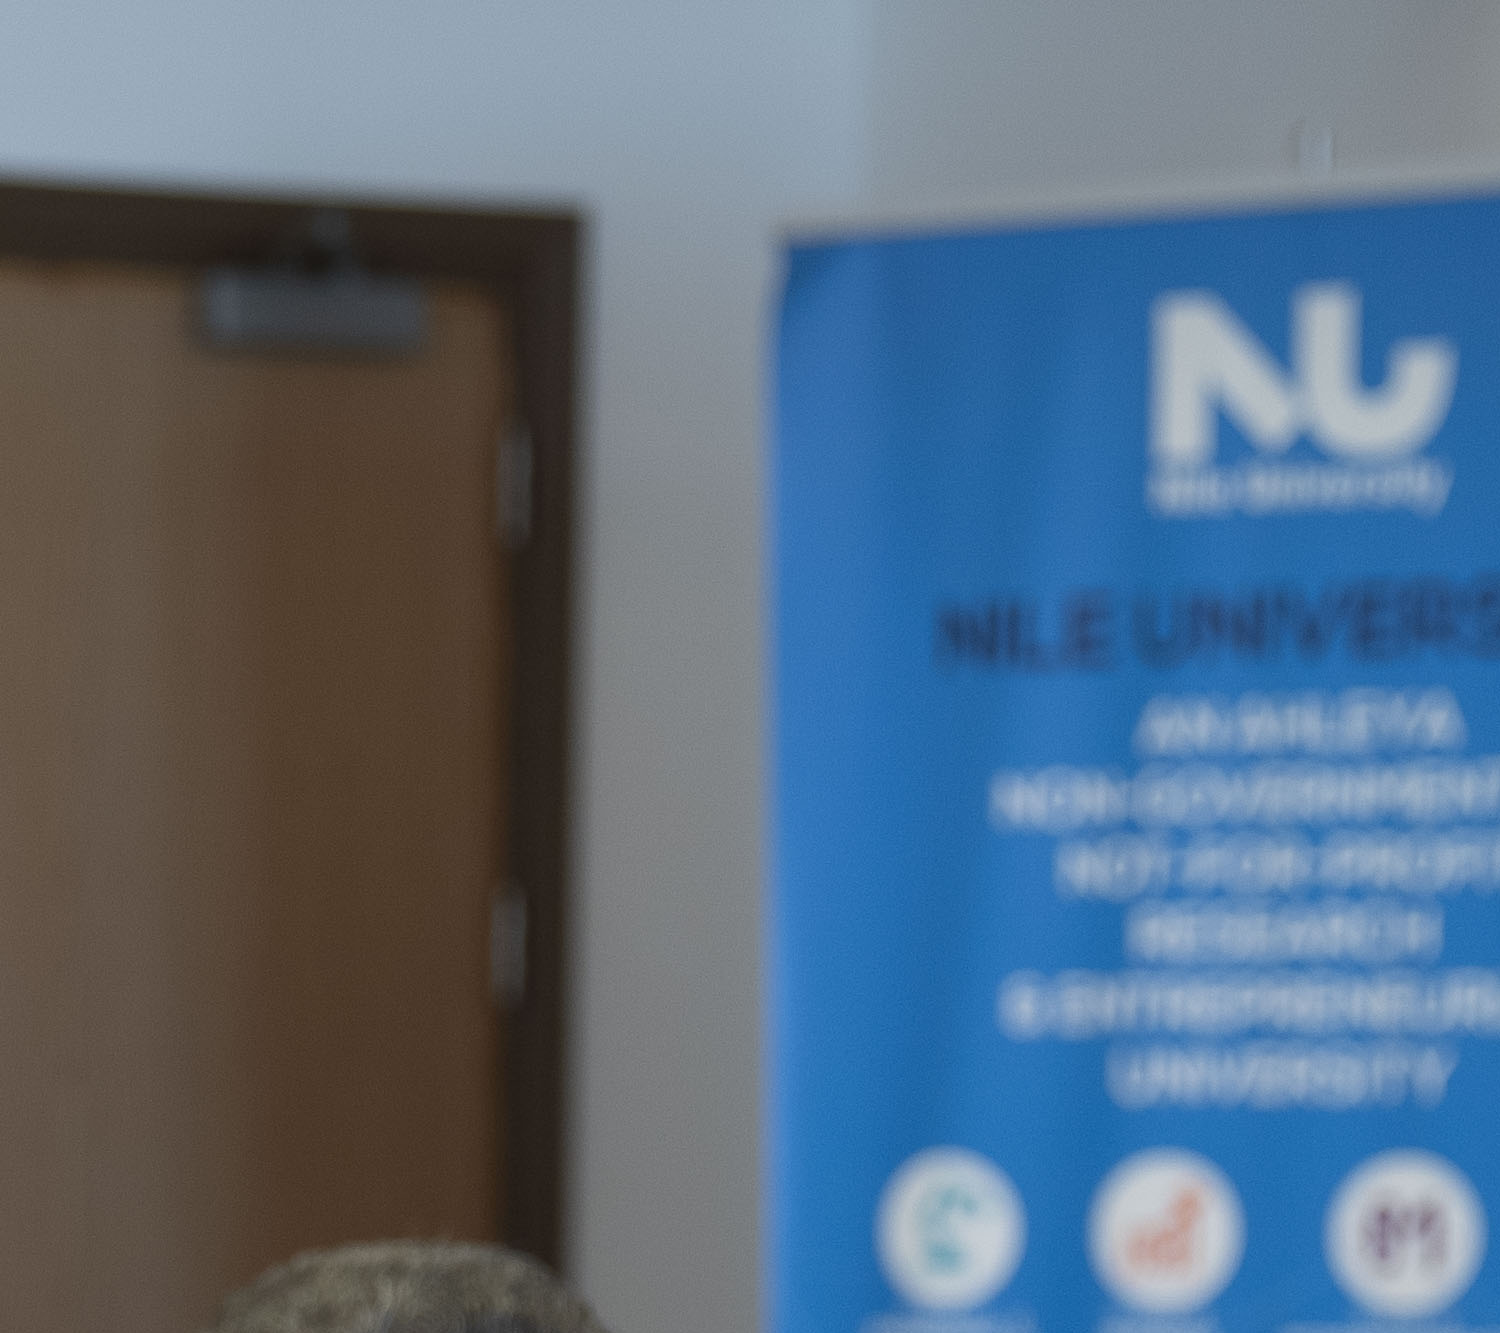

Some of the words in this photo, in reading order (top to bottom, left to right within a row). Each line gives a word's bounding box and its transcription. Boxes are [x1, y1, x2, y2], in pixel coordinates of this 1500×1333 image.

[1152, 288, 1455, 462] NU
[936, 592, 1120, 668] NILE
[1128, 902, 1440, 966] RESEARCH
[1110, 1046, 1456, 1104] UNIVERSITY
